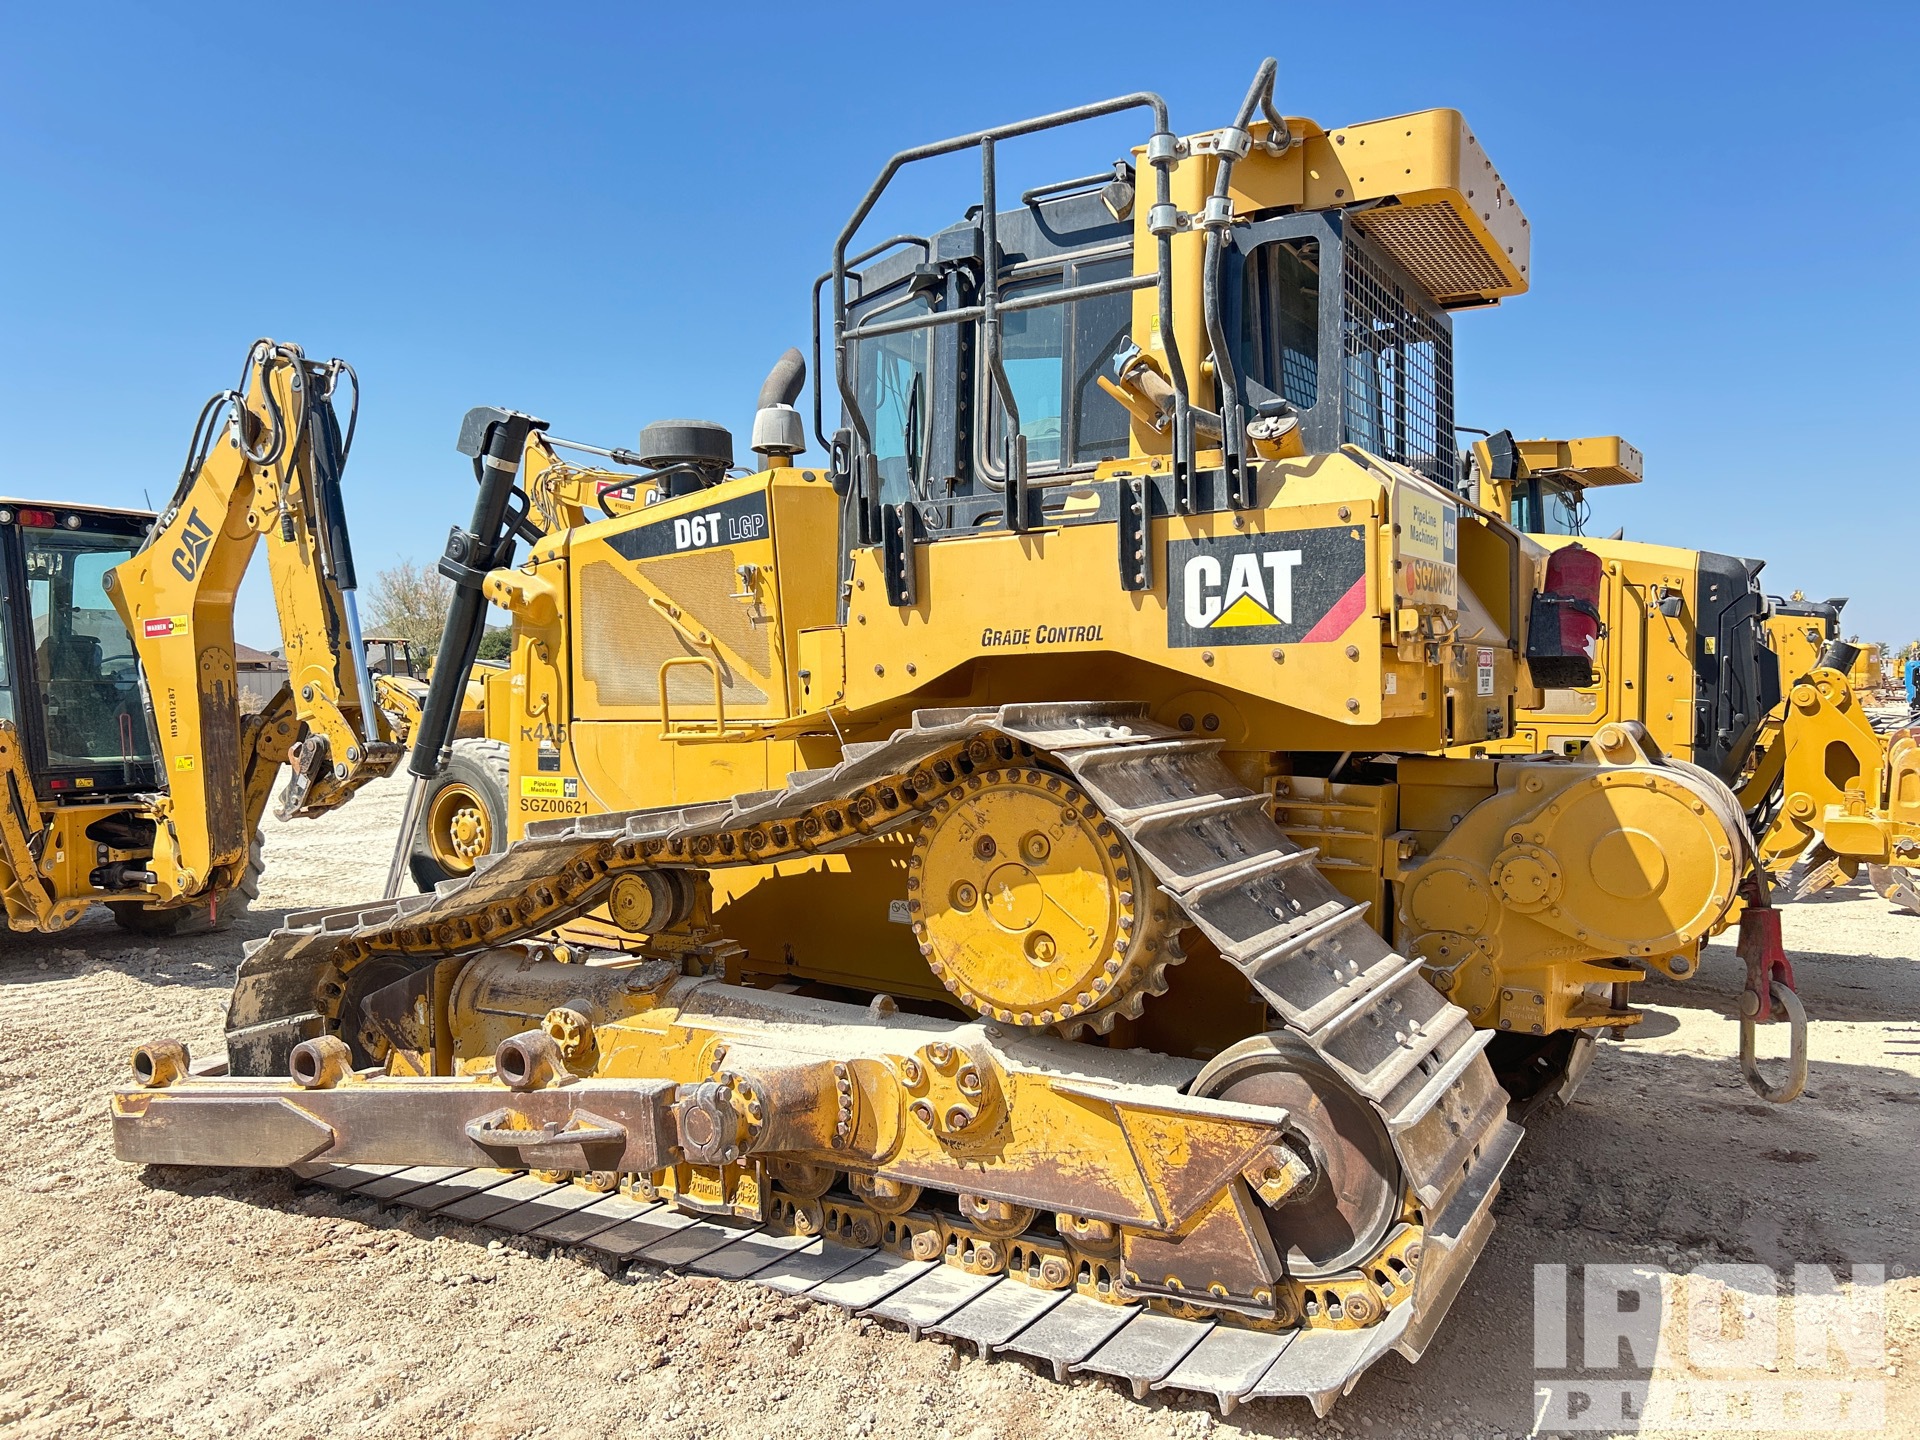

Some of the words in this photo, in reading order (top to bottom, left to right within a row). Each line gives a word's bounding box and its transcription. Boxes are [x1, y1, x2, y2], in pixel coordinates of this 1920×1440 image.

[1413, 505, 1437, 528] PipeLine
[674, 512, 721, 549] D6T
[728, 513, 764, 540] LGP
[1410, 524, 1439, 550] Machinery
[1444, 520, 1455, 550] CAT
[172, 506, 214, 582] CAT
[1184, 549, 1302, 629] CAT
[1415, 559, 1456, 597] SGZ00621
[981, 627, 1031, 647] GRADE
[1035, 624, 1104, 644] CONTROL
[530, 786, 558, 794] Machinery
[533, 780, 557, 788] PipeLine
[564, 782, 577, 793] CAT
[520, 798, 588, 814] SGZ00621
